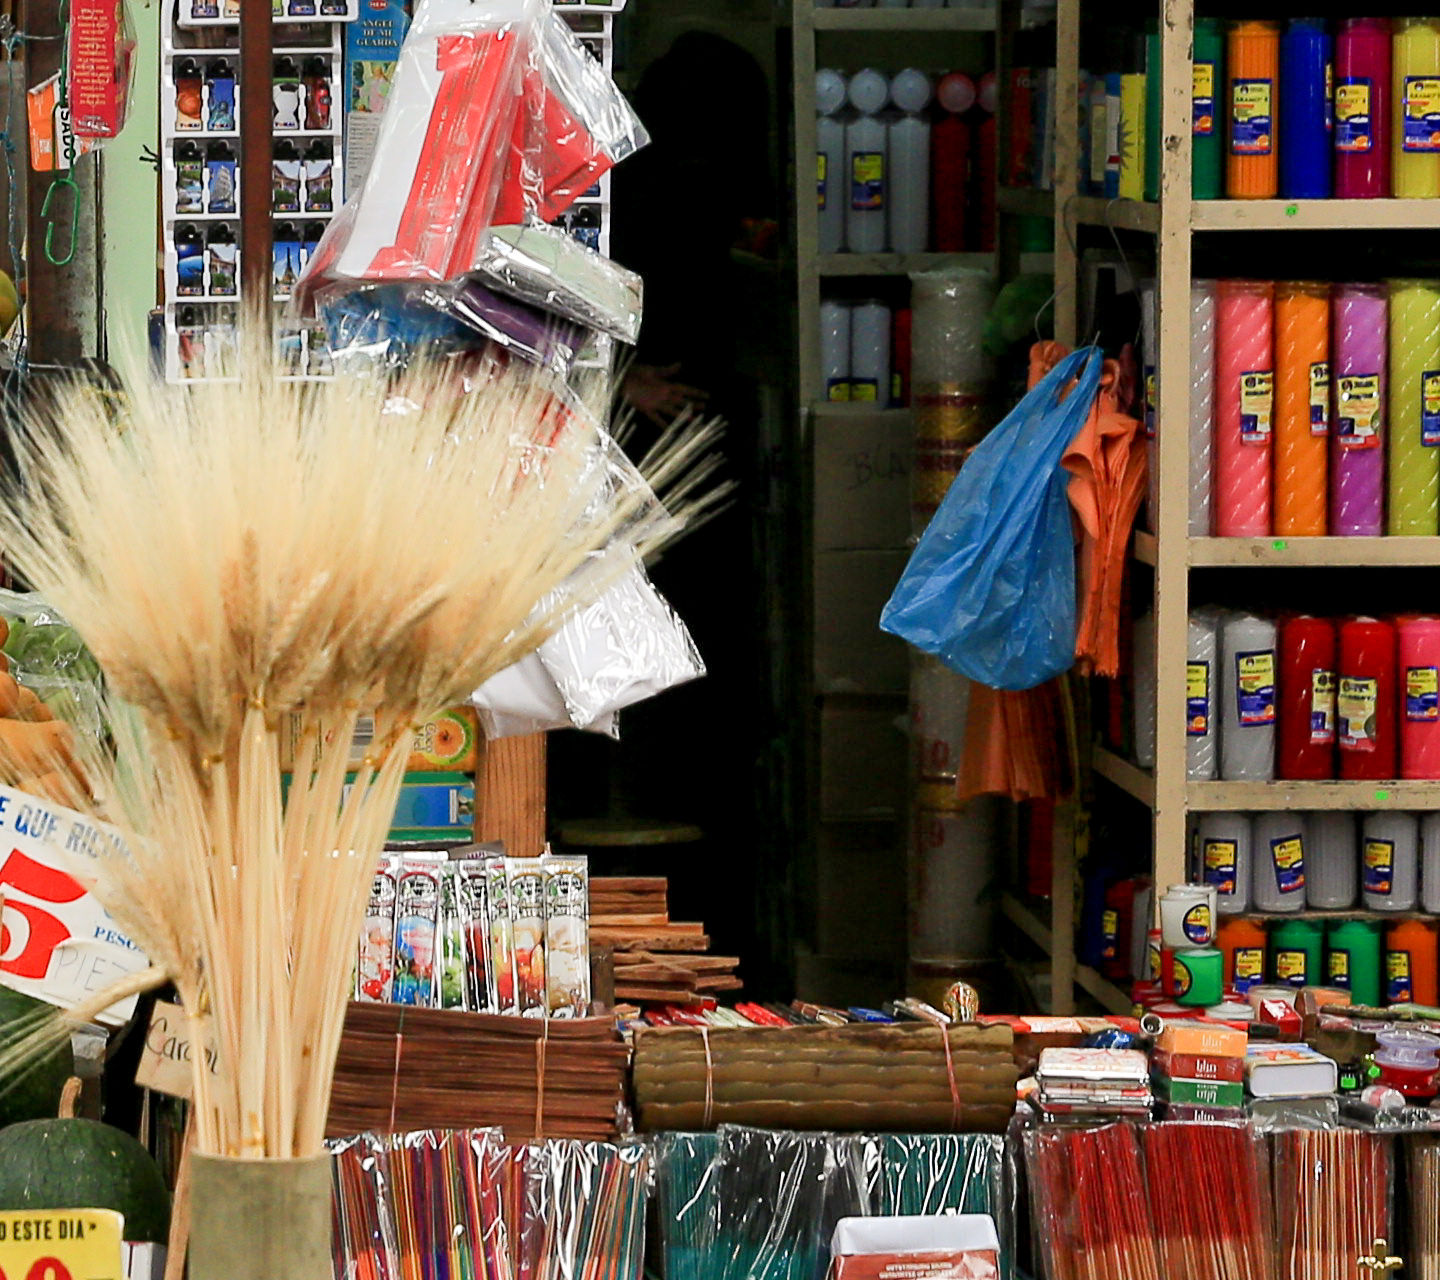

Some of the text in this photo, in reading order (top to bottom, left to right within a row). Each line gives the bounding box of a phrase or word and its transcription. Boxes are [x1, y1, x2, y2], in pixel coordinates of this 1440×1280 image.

[356, 38, 399, 48] GUARDA
[14, 803, 60, 839] QUE
[94, 924, 148, 953] PESO
[13, 1219, 53, 1242] ESTE
[58, 1219, 85, 1240] DIA
